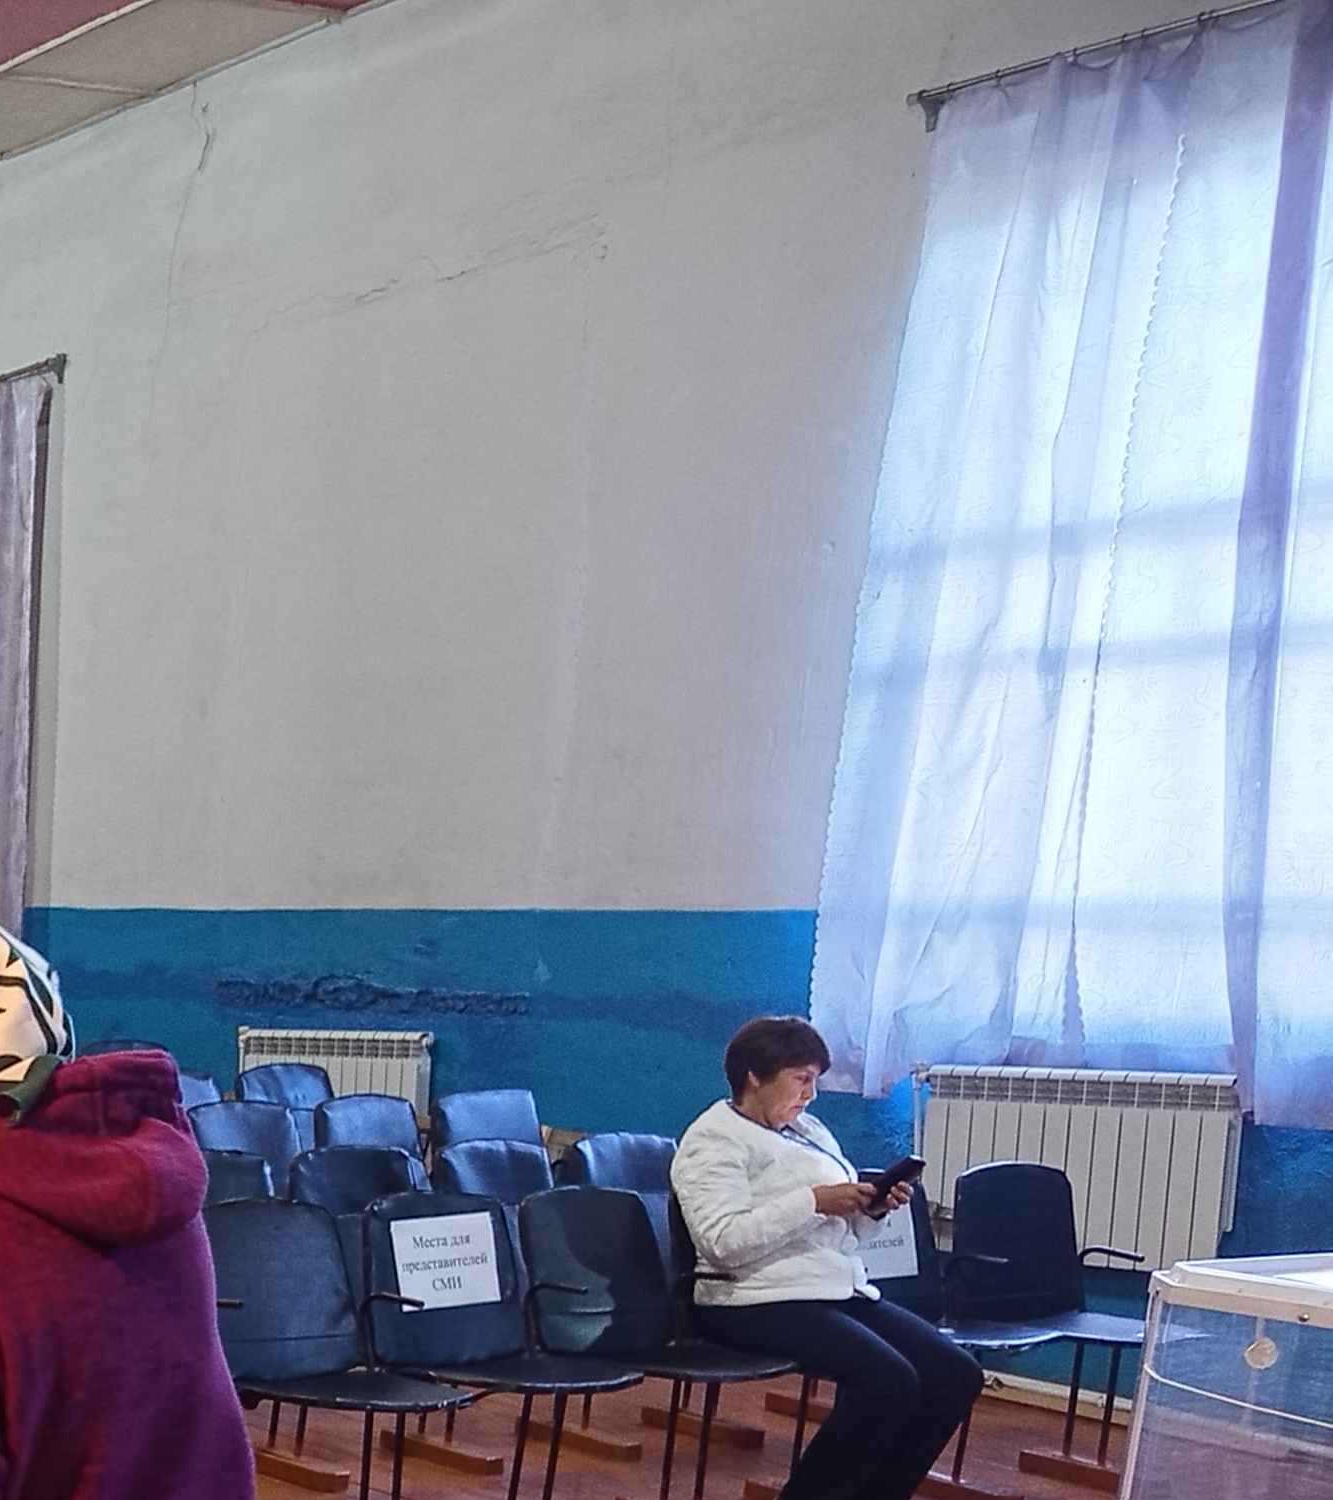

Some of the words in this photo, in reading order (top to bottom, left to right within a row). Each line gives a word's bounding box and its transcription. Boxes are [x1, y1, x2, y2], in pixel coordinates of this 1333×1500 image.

[412, 1235, 448, 1250] Места
[450, 1234, 471, 1247] для
[401, 1252, 488, 1275] представителей
[431, 1275, 463, 1291] СМИ
